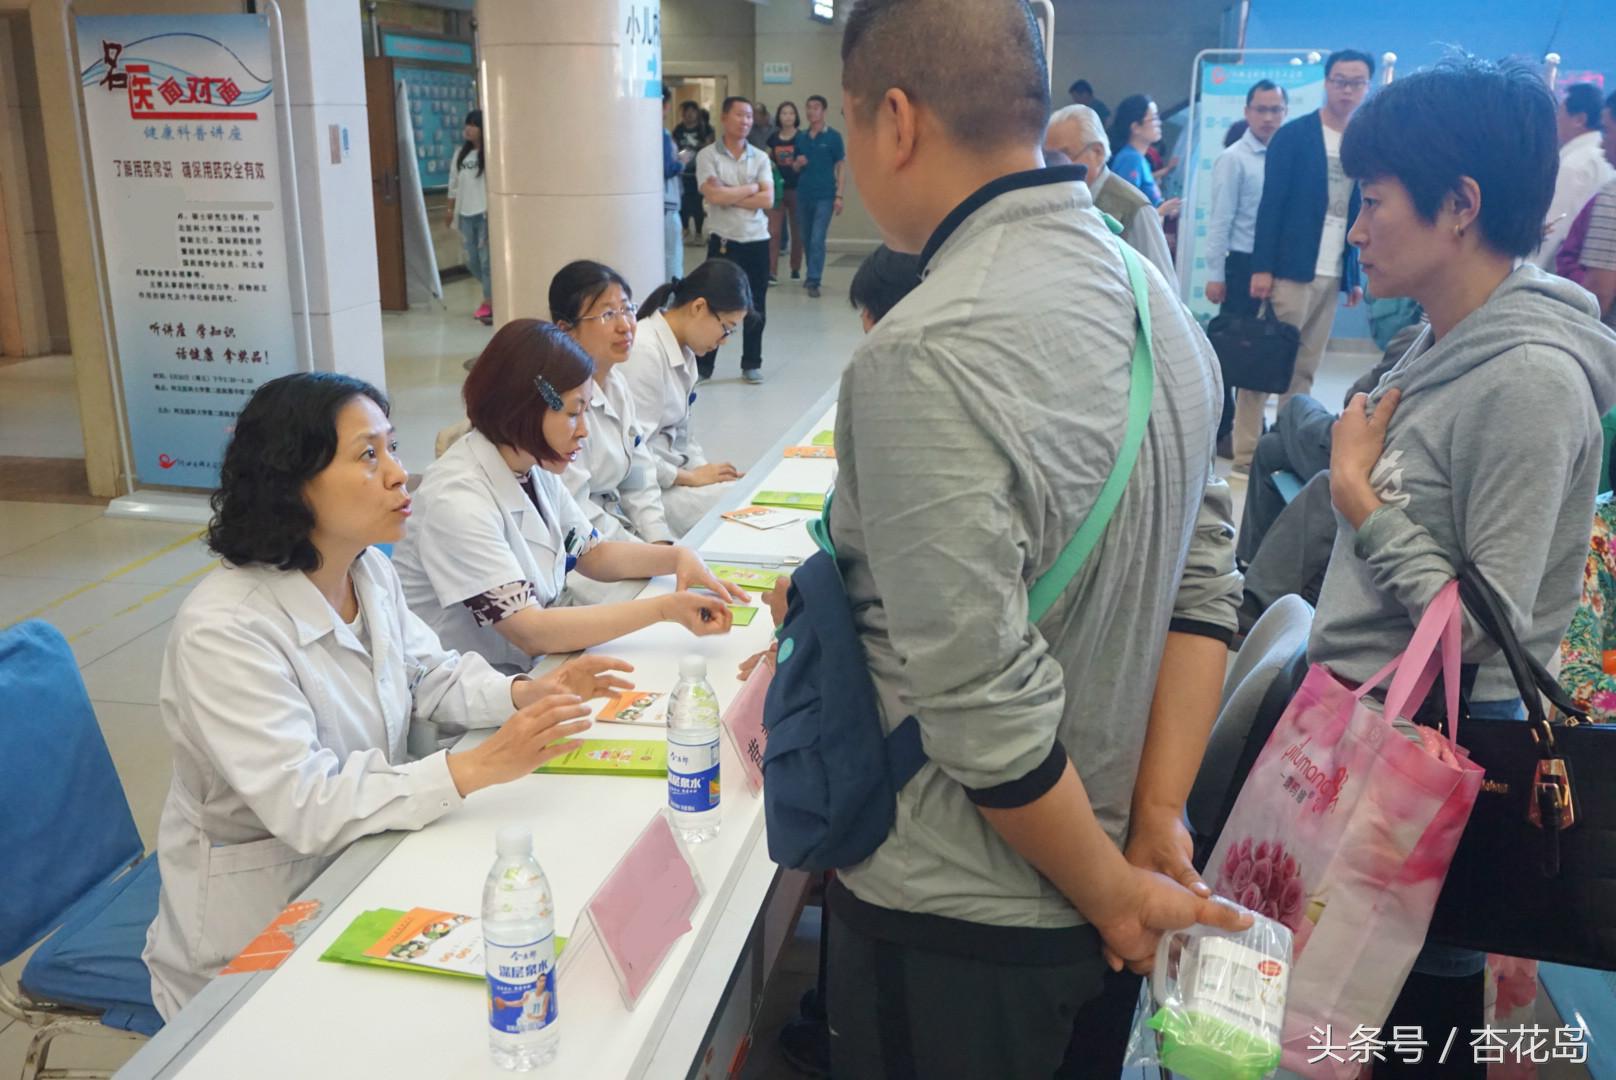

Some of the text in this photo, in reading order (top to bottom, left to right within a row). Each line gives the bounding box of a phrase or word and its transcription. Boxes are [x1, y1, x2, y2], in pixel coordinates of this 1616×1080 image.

[100, 40, 257, 119] 名医面对面
[144, 124, 243, 141] 健康科普讲座
[113, 160, 265, 180] 了解用药常识 确保用药安全有效
[149, 322, 236, 339] 听讲座 学知识
